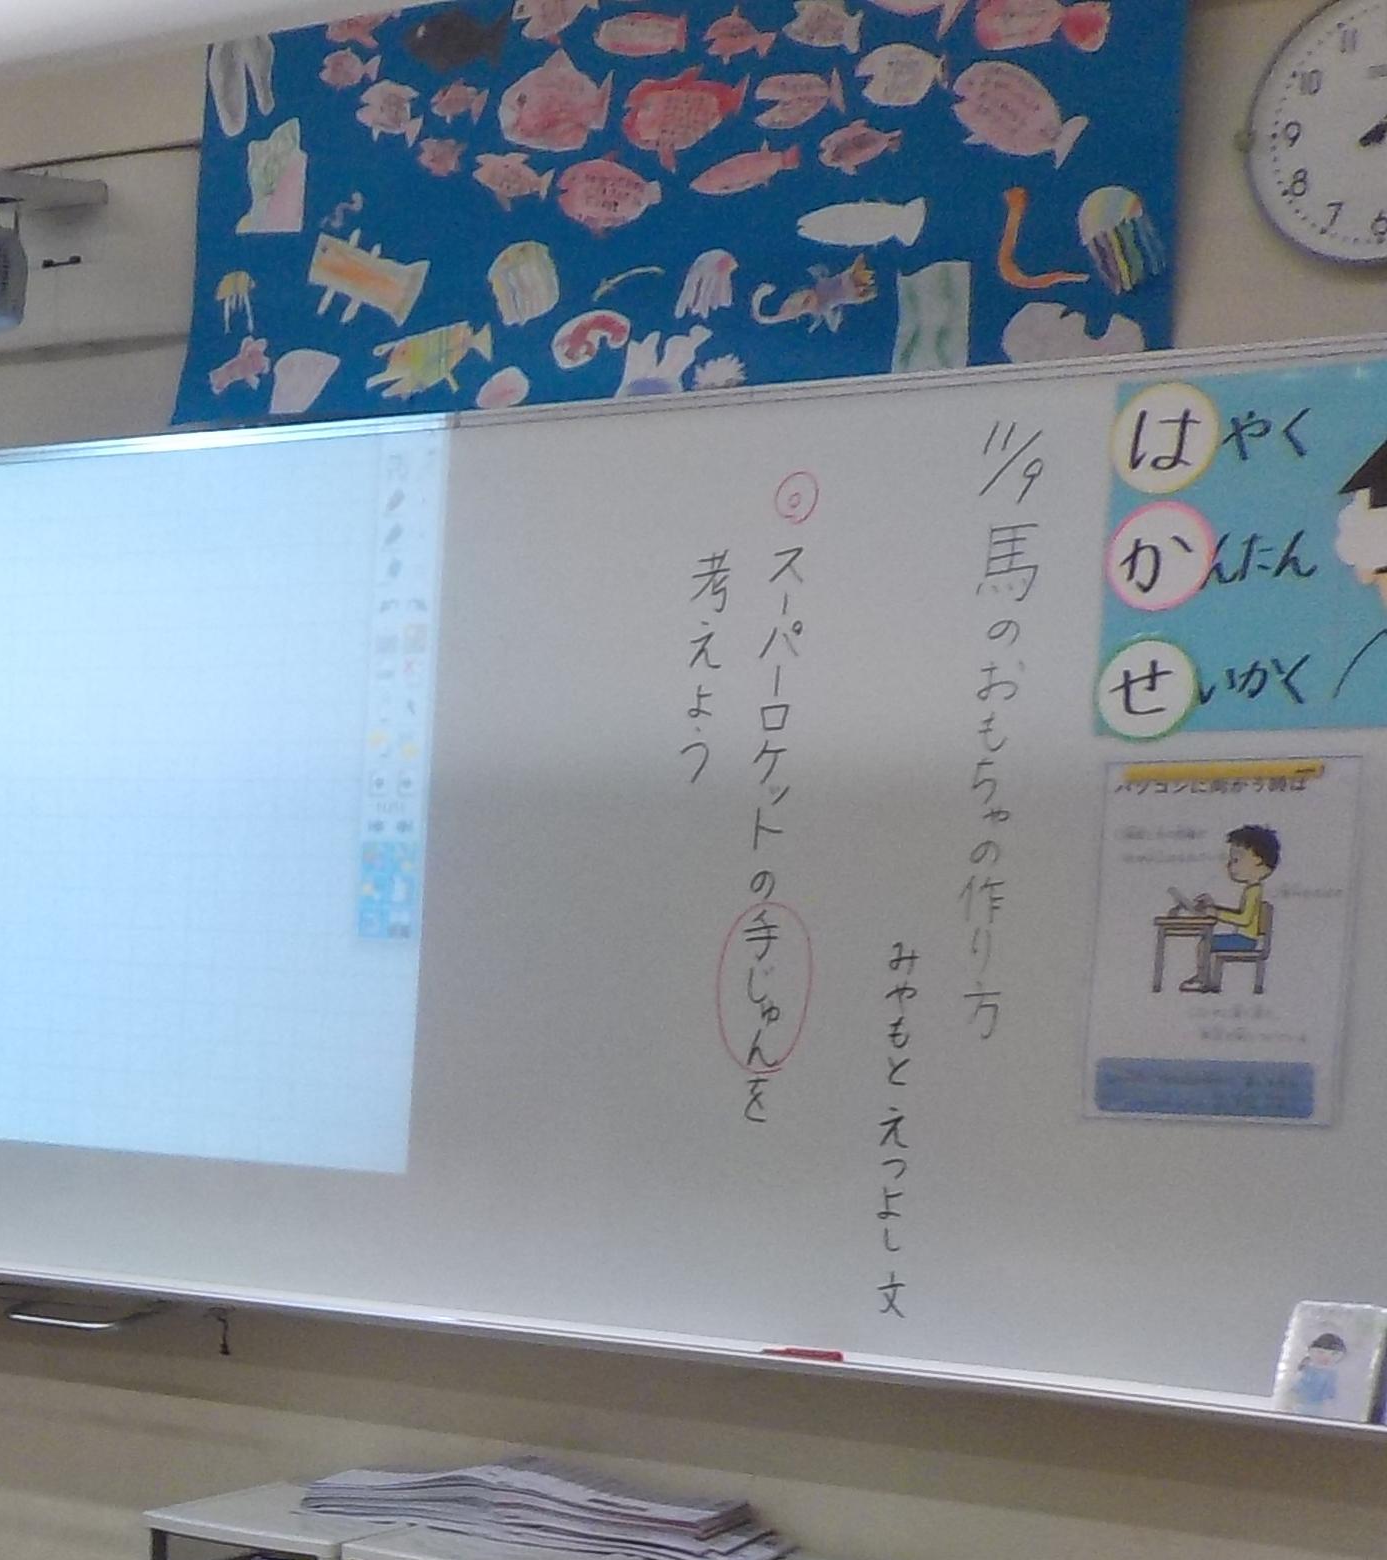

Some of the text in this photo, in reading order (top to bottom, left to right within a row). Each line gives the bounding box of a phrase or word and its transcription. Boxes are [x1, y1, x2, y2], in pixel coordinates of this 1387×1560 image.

[1284, 121, 1302, 148] 9
[1290, 168, 1308, 197] 8
[1326, 202, 1344, 227] 7
[1371, 209, 1387, 236] 6
[1129, 406, 1312, 472] はやく
[1121, 532, 1318, 594] かんたん
[679, 549, 731, 785] 考えよう
[1108, 653, 1313, 716] せいかく
[960, 522, 1040, 1040] 馬のおもちゃの作り方
[876, 941, 920, 1319] みやもと えつよし 文
